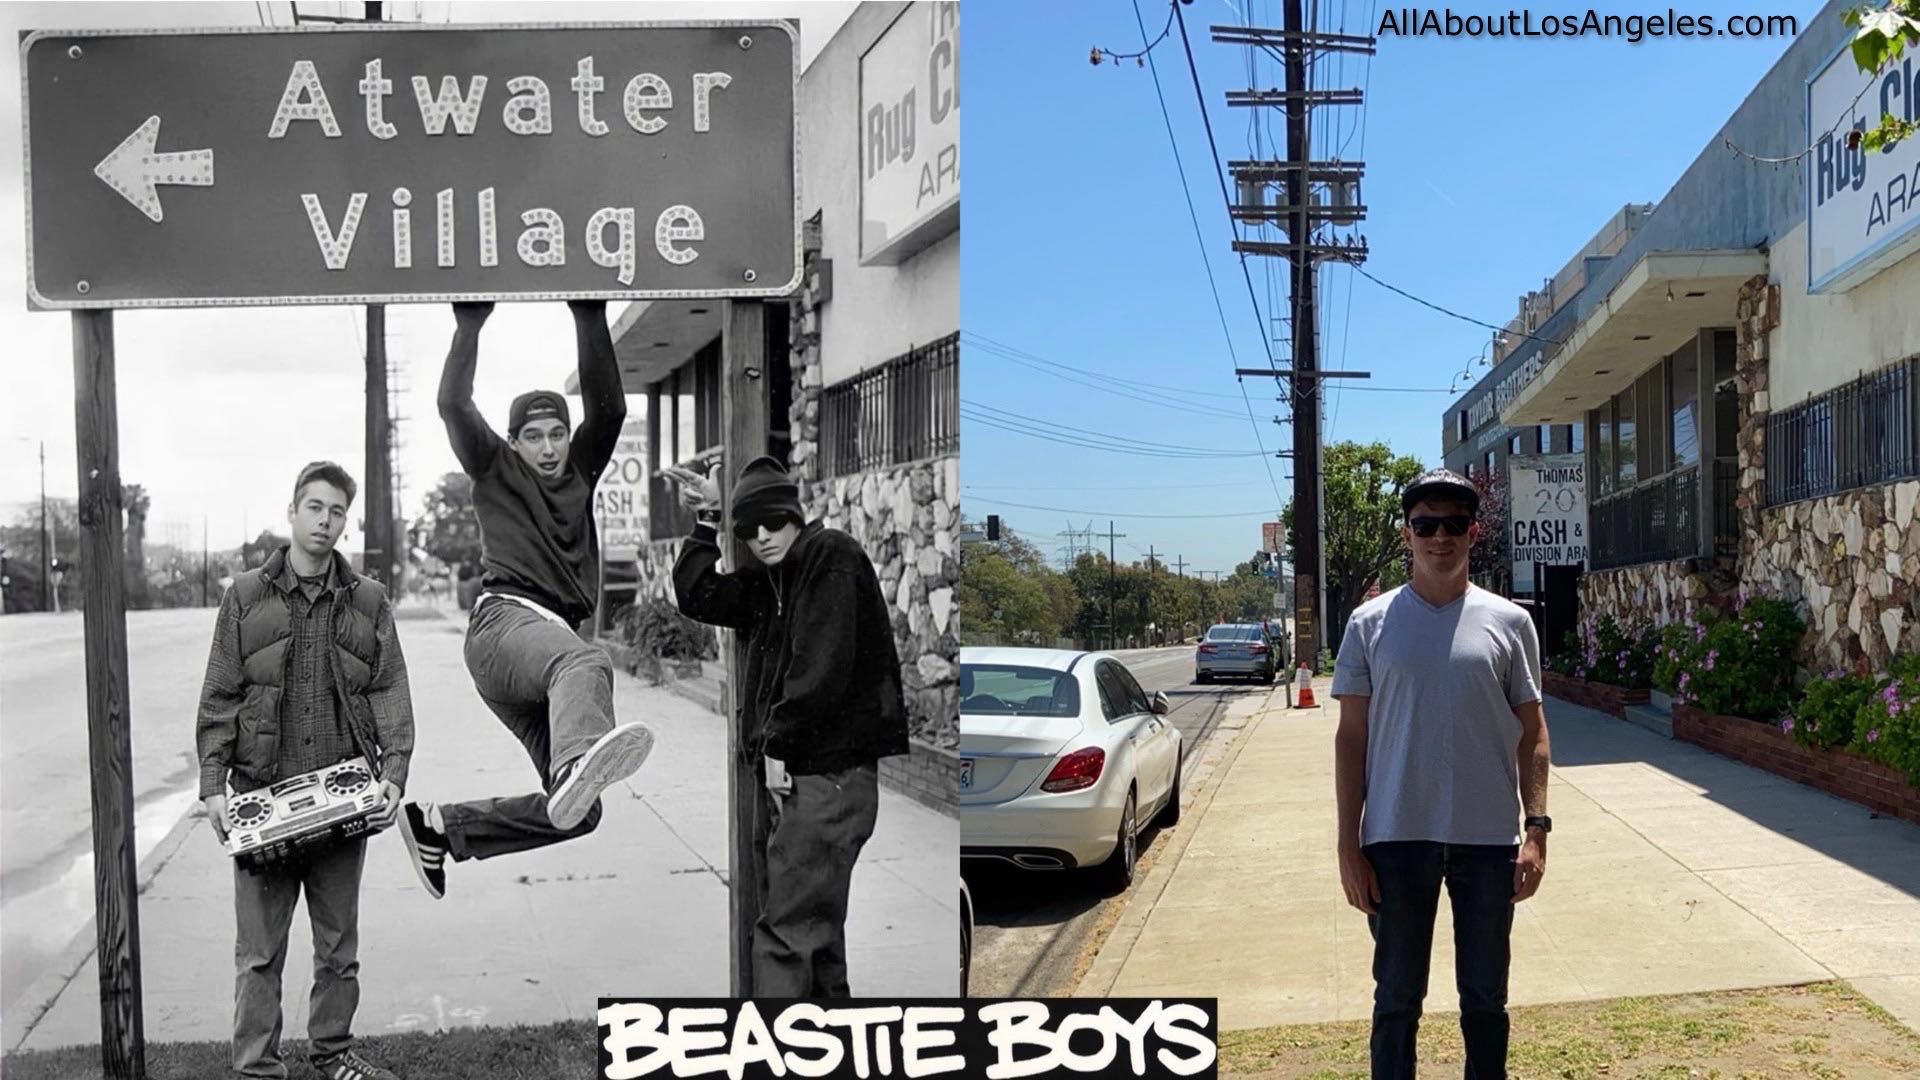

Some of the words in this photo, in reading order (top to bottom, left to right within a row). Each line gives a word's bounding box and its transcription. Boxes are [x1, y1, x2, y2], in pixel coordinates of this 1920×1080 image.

[268, 56, 732, 139] Atwater
[868, 86, 916, 180] Rug
[301, 186, 704, 286] Village
[604, 458, 642, 485] 20
[1536, 467, 1583, 483] THOMAS
[1535, 488, 1575, 514] 20
[1514, 520, 1567, 546] CASH
[1514, 546, 1562, 562] DIVISION
